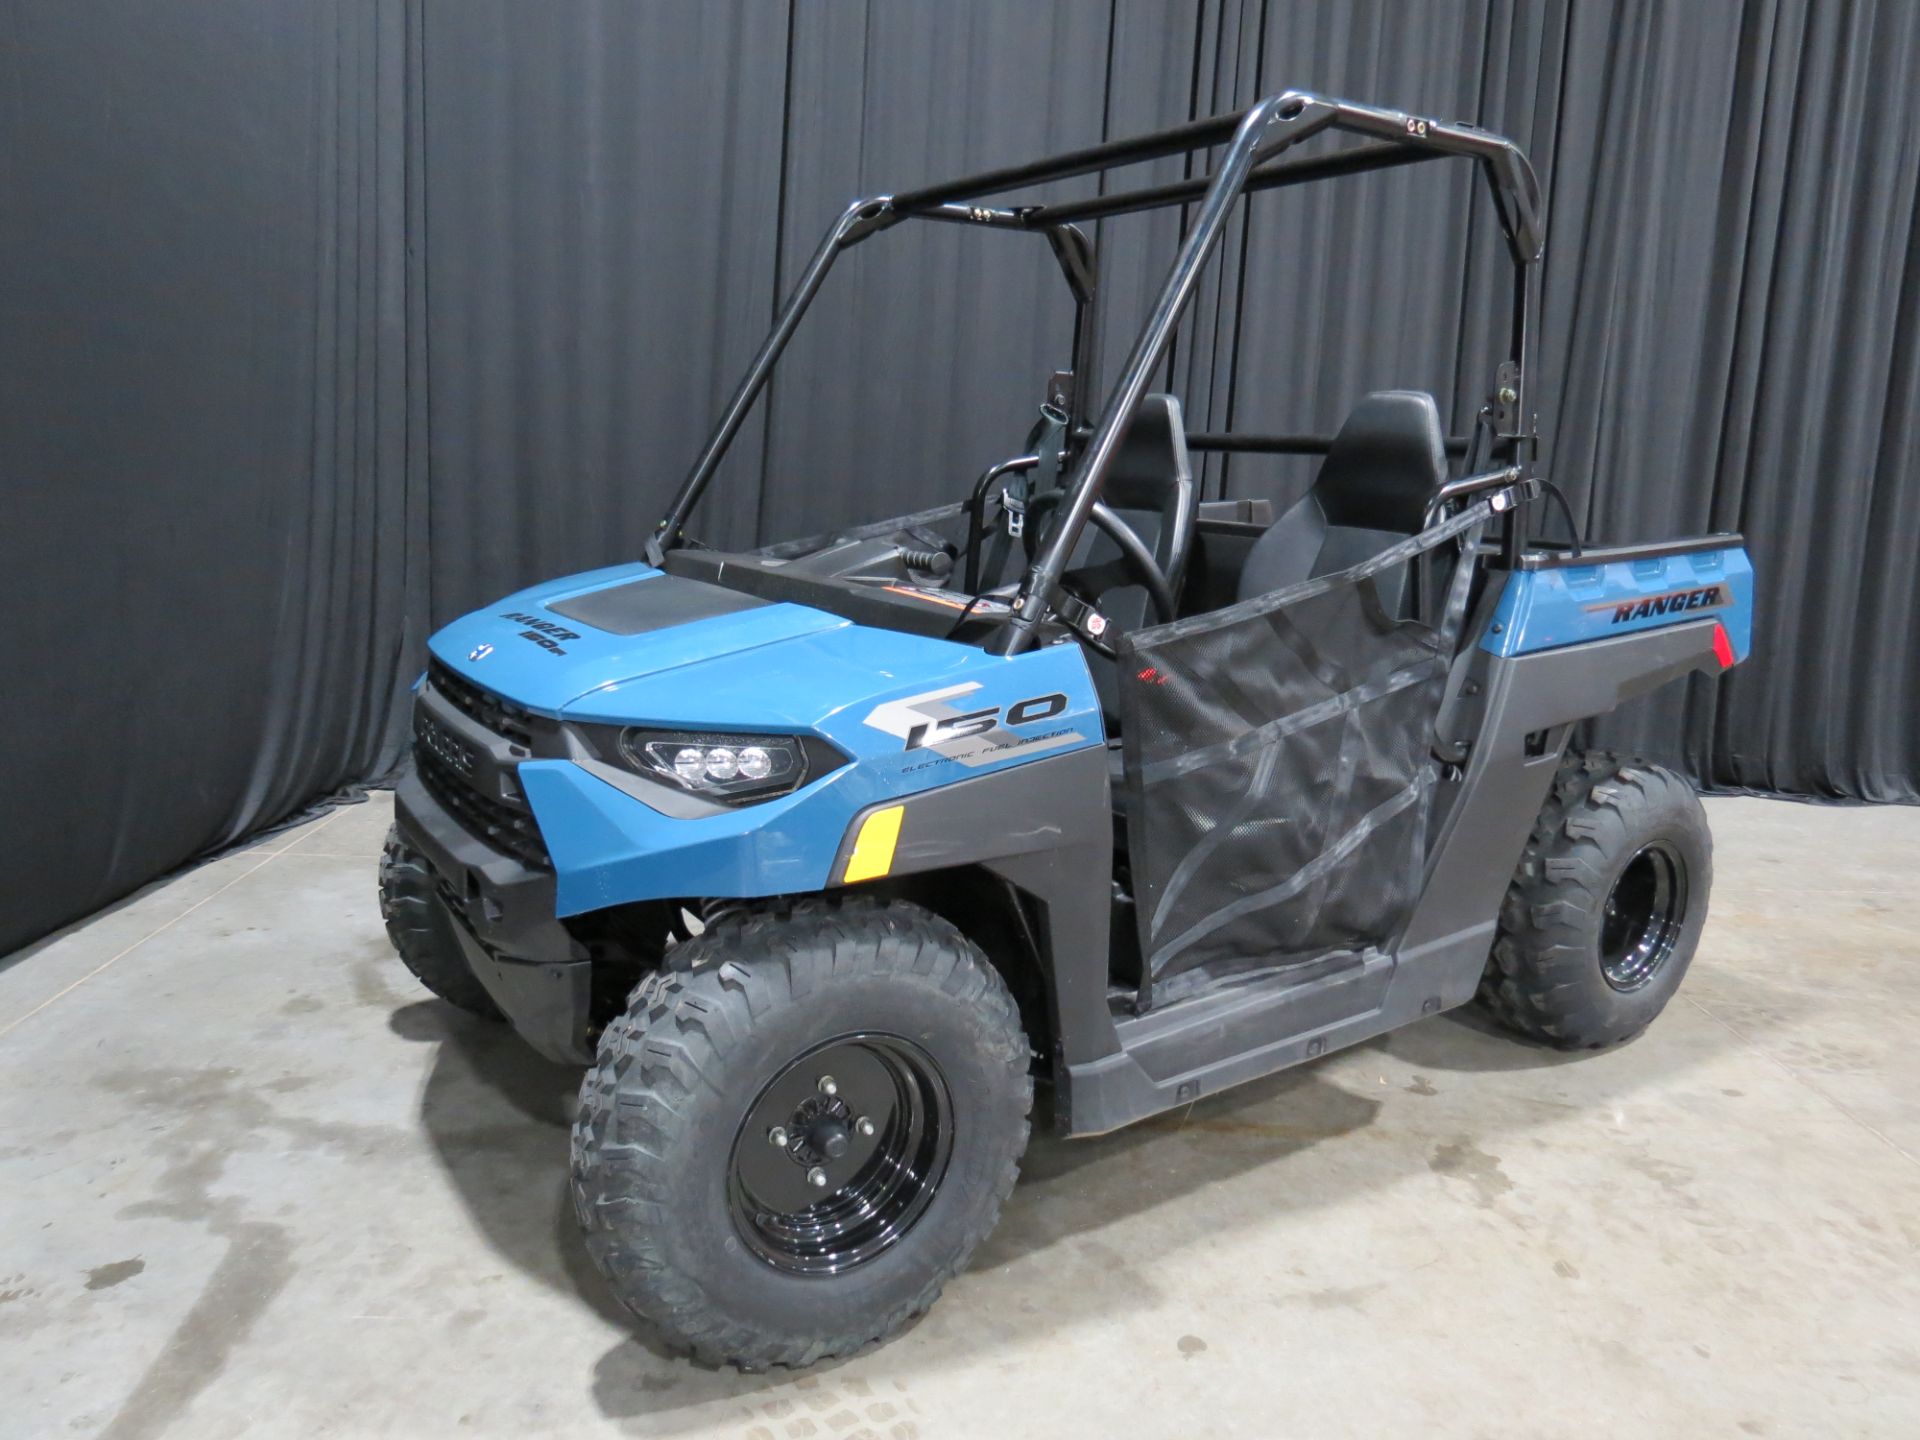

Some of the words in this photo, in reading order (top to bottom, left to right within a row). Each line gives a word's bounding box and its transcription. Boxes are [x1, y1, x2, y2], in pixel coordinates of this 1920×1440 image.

[1611, 586, 1721, 625] RANGER
[499, 612, 581, 640] RANGER
[905, 692, 1068, 751] 150
[902, 751, 976, 774] ELECTRONIC
[981, 743, 1012, 755] FUEL
